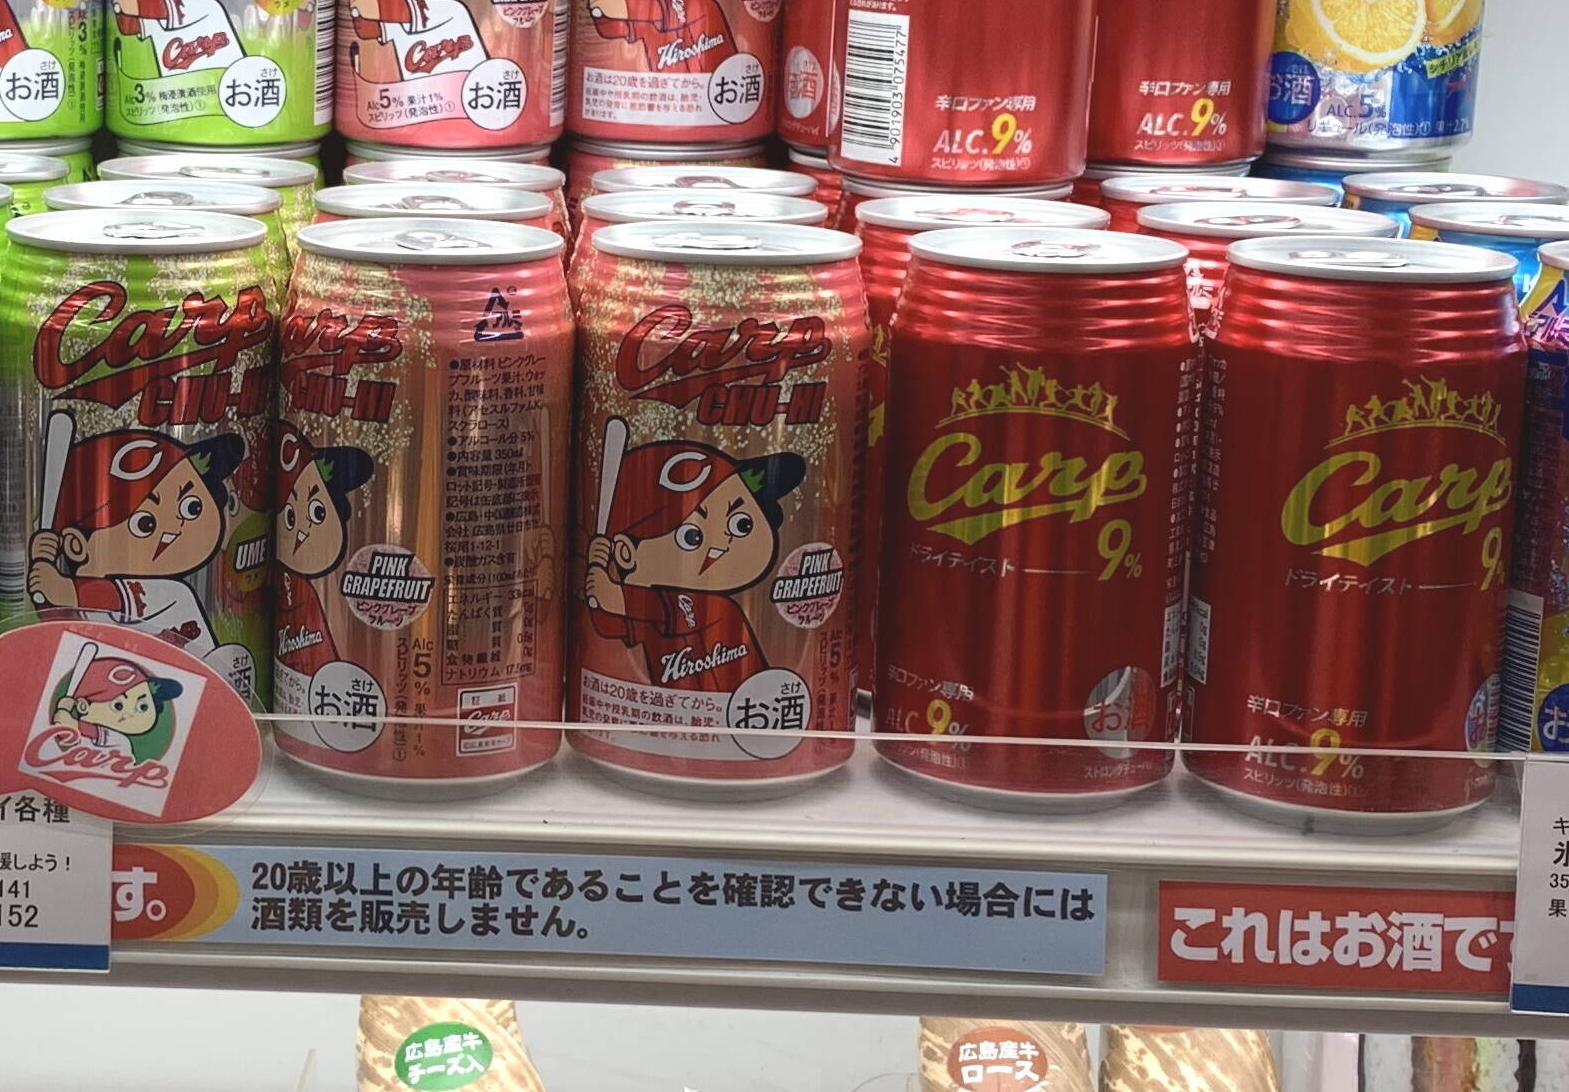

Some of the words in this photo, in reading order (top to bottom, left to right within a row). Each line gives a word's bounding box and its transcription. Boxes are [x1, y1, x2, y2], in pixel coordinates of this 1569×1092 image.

[657, 32, 725, 69] Hiroshima
[5, 72, 59, 100] お酒
[225, 79, 281, 107] お酒
[467, 81, 522, 110] お酒
[714, 74, 761, 104] お酒
[33, 280, 273, 408] Carp
[616, 306, 833, 399] Carp
[696, 382, 827, 426] CHU-HI
[907, 432, 1147, 545] Carp
[1280, 451, 1512, 566] Carp
[234, 539, 267, 572] UME
[370, 554, 410, 577] PINK
[801, 552, 830, 575] PINK
[909, 544, 1014, 577] ドライテイスト
[341, 575, 432, 599] GRAPEFRUIT
[773, 572, 843, 601] GRAPEFRUIT
[1284, 567, 1412, 596] ドライテイスト
[661, 643, 748, 684] Hiroshima
[315, 690, 380, 734] お酒
[1247, 694, 1368, 727] 辛口ファン専用
[24, 725, 169, 791] Carp
[251, 860, 1095, 922] 20歳以上の年齢であることを確認できない場合には
[251, 896, 591, 940] 酒類を販売しません。
[405, 1032, 483, 1063] 広島産牛
[958, 1040, 1039, 1062] 広島産牛
[961, 1060, 1040, 1084] ロース
